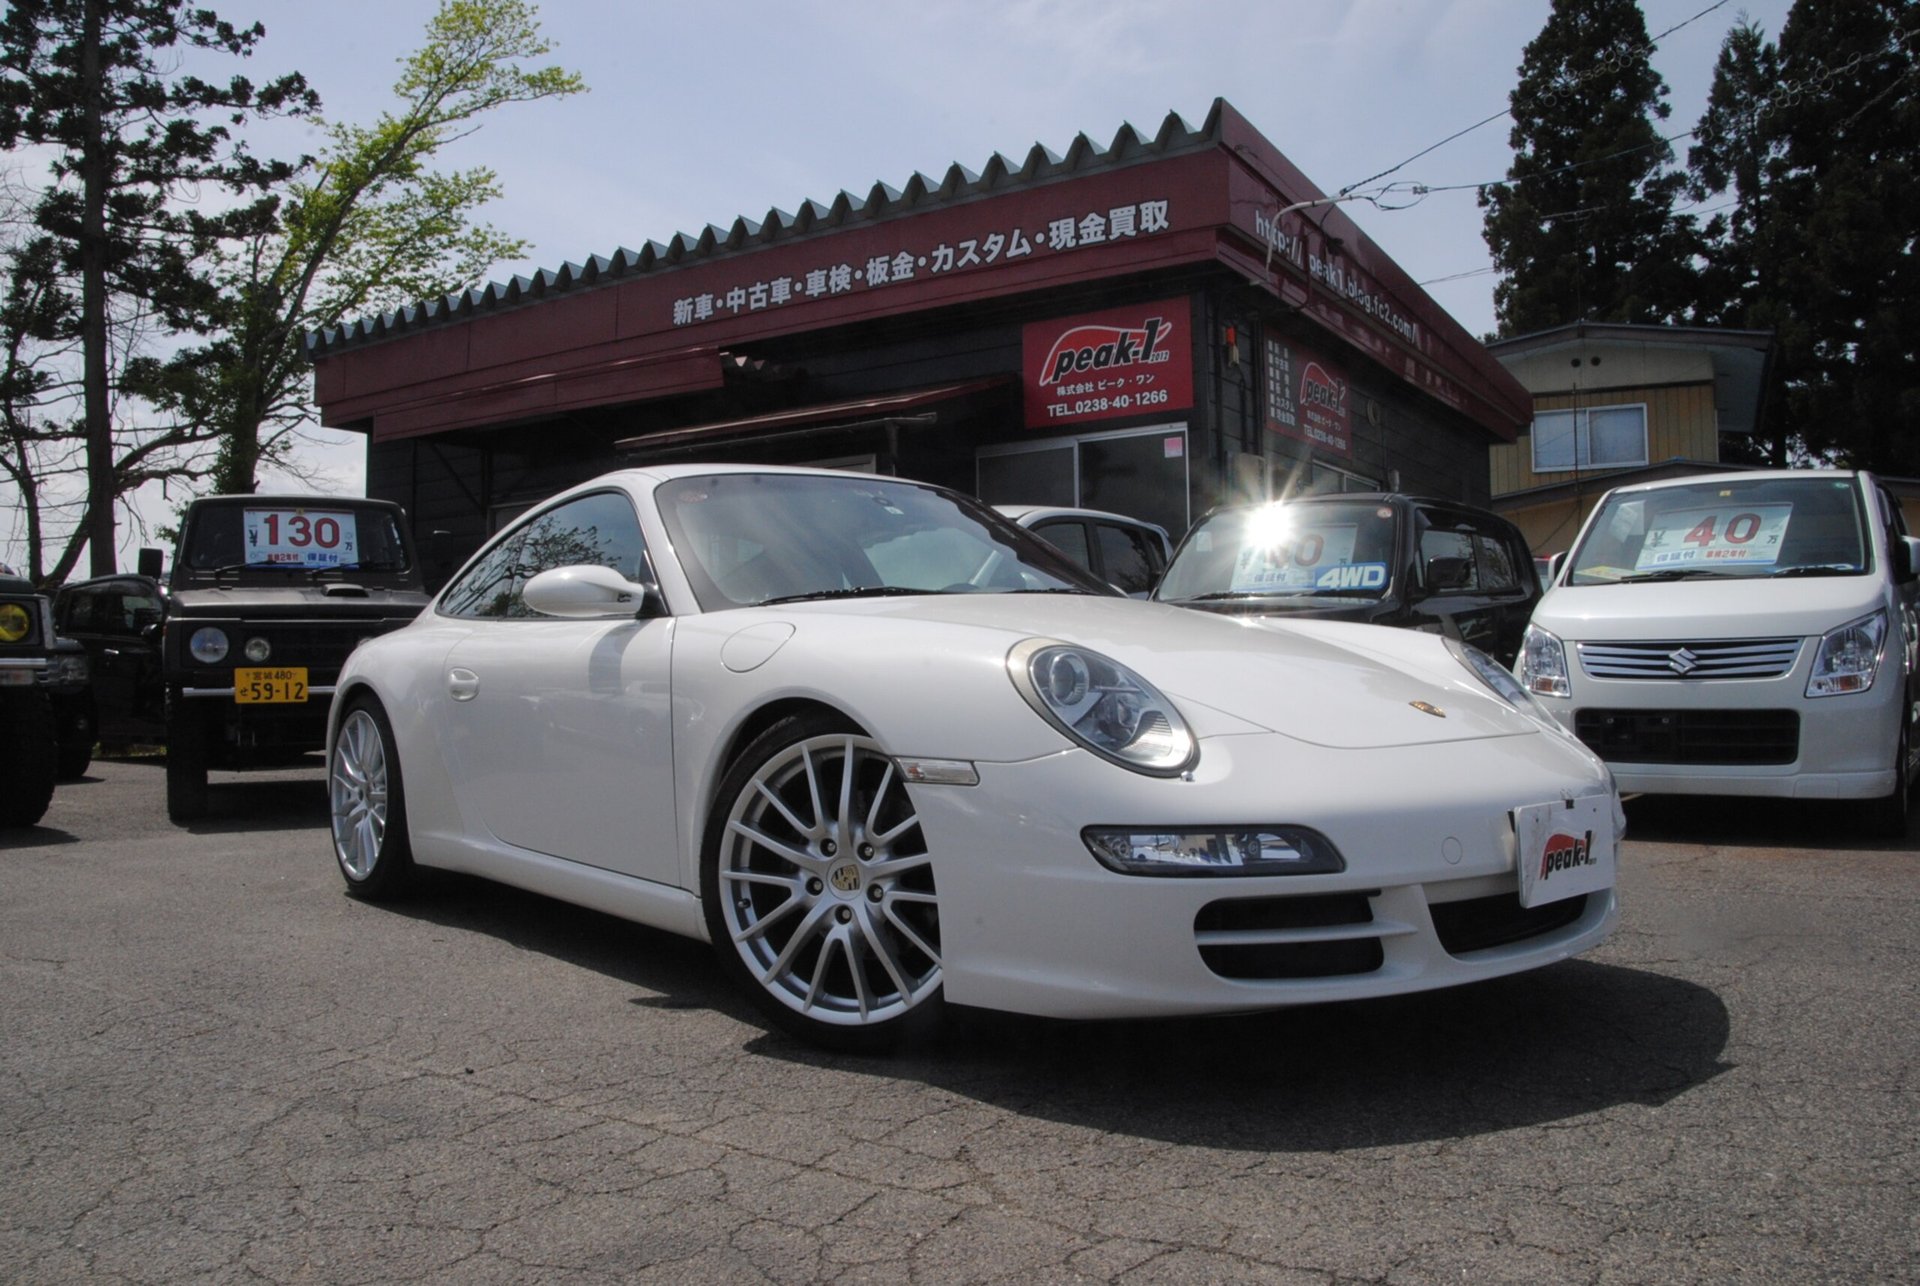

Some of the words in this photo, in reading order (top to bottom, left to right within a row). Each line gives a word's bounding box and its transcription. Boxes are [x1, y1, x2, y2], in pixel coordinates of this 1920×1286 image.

[1050, 317, 1163, 385] peak-1
[1047, 389, 1168, 418] TEL.0238-40-1266
[263, 513, 340, 549] 130
[1683, 513, 1762, 548] 40
[1317, 565, 1385, 588] 4WD
[251, 682, 304, 700] 59-12
[274, 670, 293, 681] 480
[1544, 830, 1592, 880] peak-1
